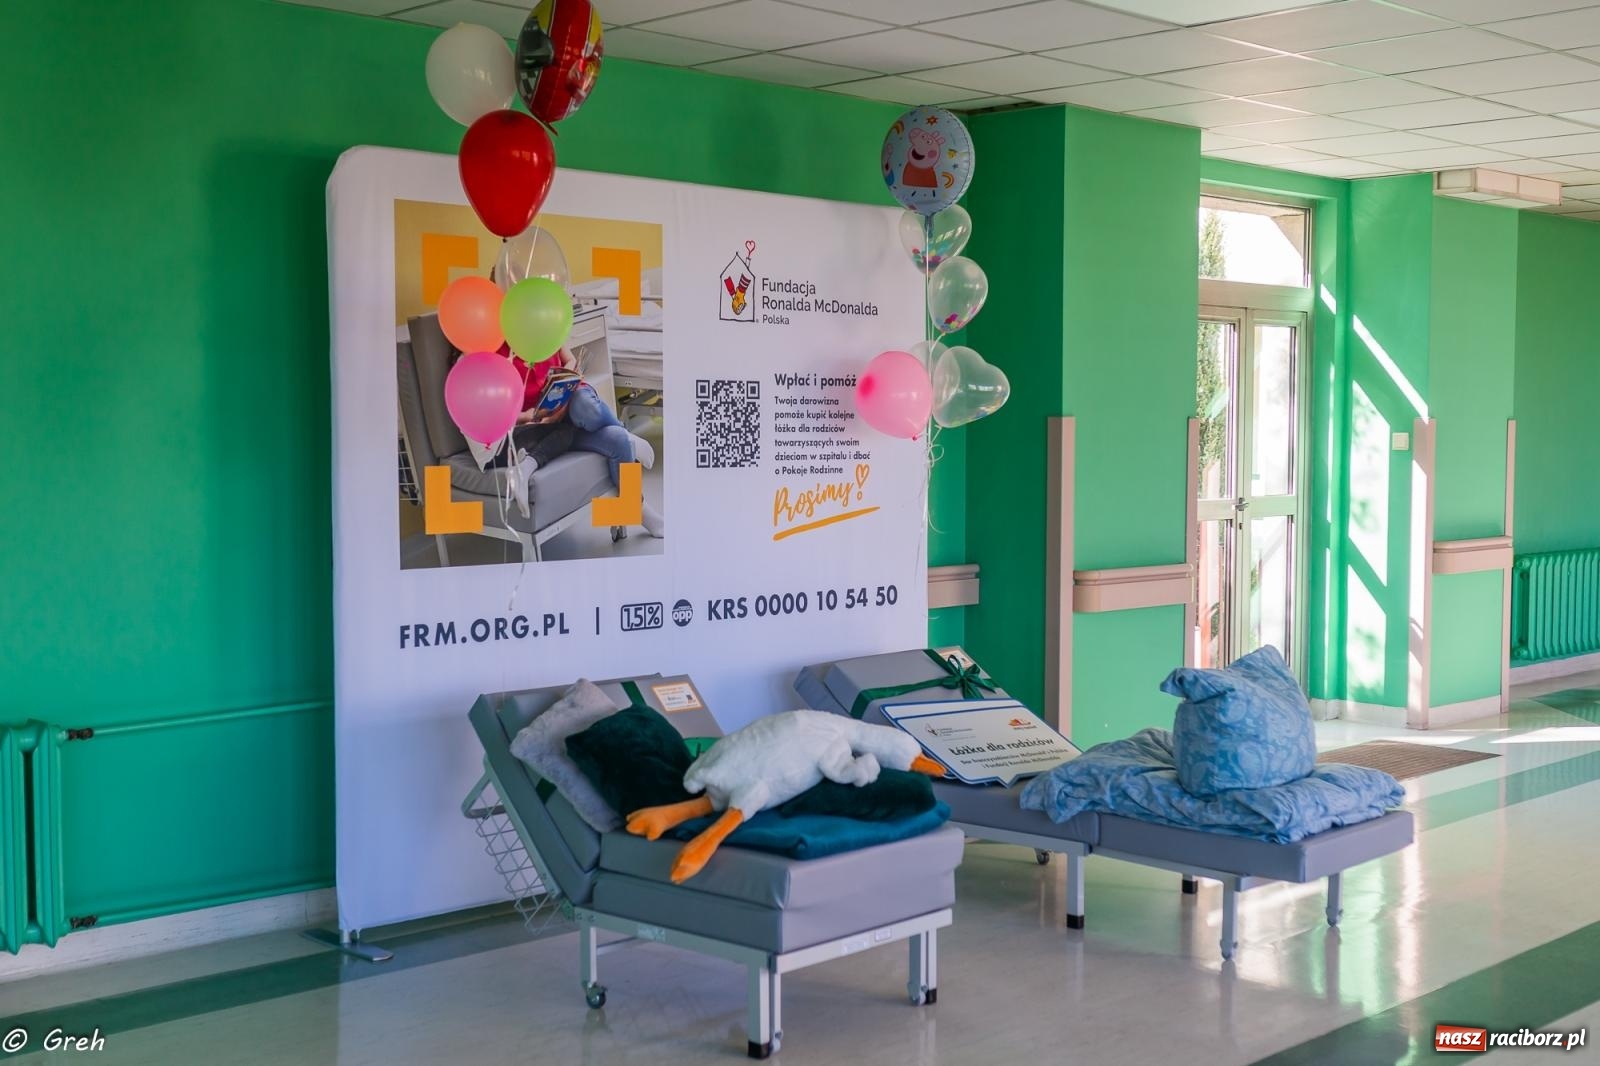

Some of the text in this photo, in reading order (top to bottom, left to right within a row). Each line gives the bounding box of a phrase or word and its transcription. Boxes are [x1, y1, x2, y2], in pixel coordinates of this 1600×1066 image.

[762, 278, 816, 297] Fundacja
[762, 295, 878, 315] Ronalda McDonalda
[762, 314, 790, 325] Polska
[774, 372, 857, 390] Wpłać i pomóż
[774, 395, 839, 407] Twoja darowizna
[774, 409, 855, 421] pomoże kupić kolejne
[774, 423, 846, 432] łóżka dla rodziców
[774, 437, 860, 449] towarzyszących swoim
[774, 452, 808, 461] dzieciom
[819, 451, 847, 462] szpitalu
[848, 451, 852, 460] i
[853, 450, 871, 460] dbać
[782, 465, 808, 477] Pokoje
[809, 465, 844, 475] Rodzinne
[400, 612, 570, 650] FRM.ORG.PL
[671, 609, 694, 623] opp
[707, 597, 748, 621] KRS
[754, 591, 808, 617] 0000
[816, 589, 838, 611] 10
[845, 587, 869, 609] 54
[875, 584, 898, 607] 50
[986, 742, 1006, 752] dla
[1007, 738, 1055, 750] rodziców
